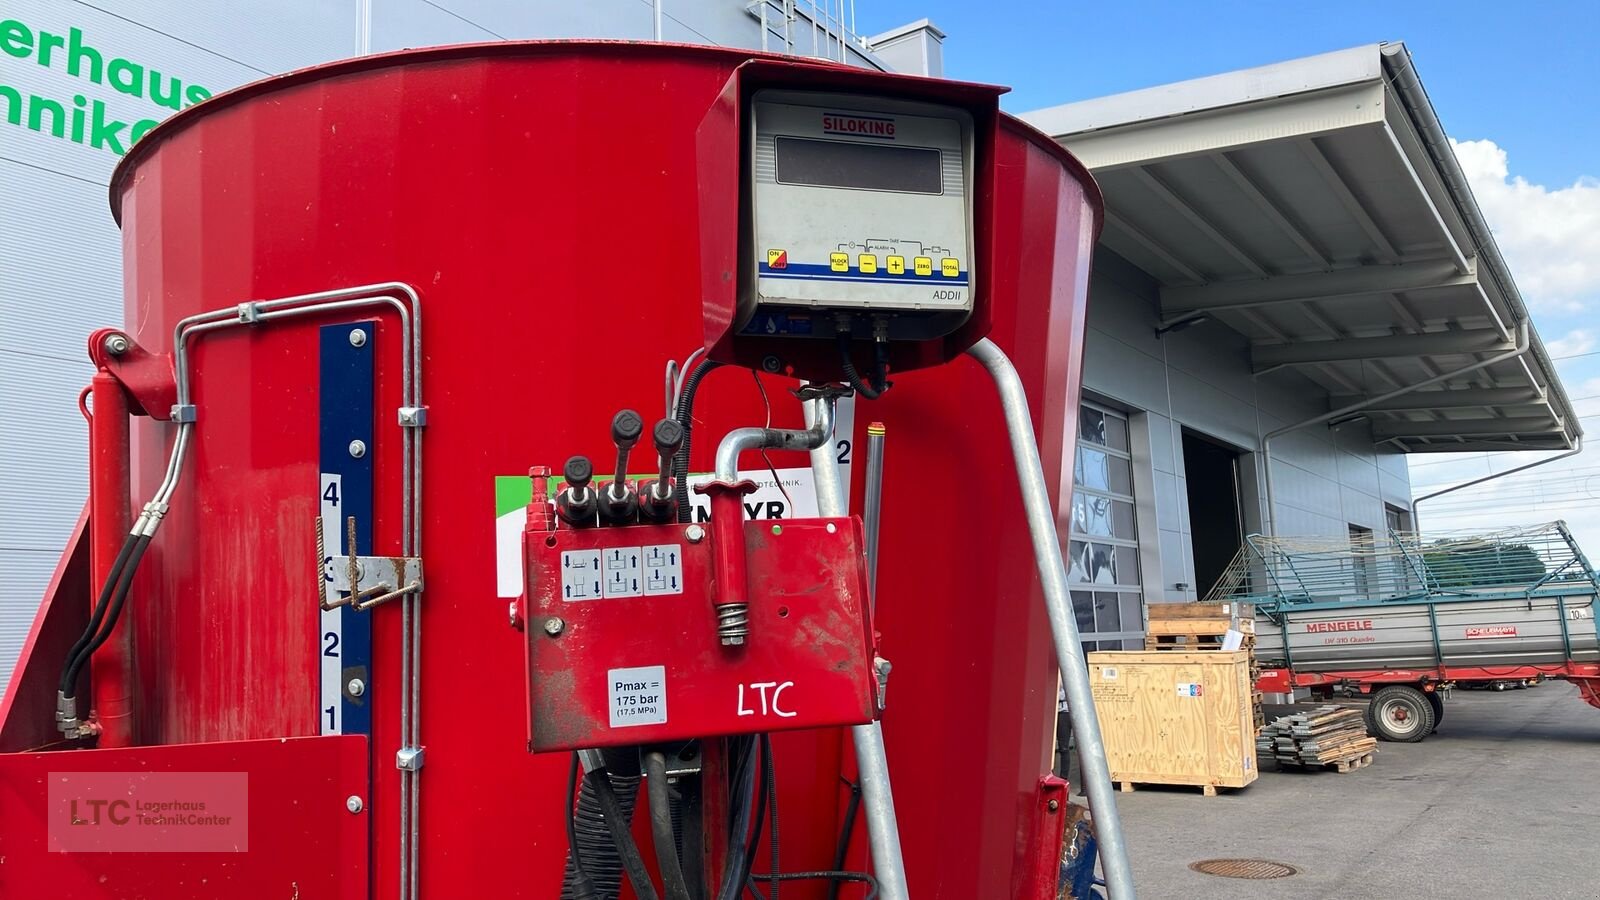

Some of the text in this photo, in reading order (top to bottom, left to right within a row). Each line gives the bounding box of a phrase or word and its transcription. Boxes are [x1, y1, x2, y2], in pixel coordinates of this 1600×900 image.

[823, 117, 895, 135] SILOKING
[837, 440, 851, 464] 2
[323, 482, 339, 507] 4
[1307, 621, 1372, 632] MENGELE
[323, 632, 339, 657] 2
[615, 682, 647, 691] Pmax
[616, 695, 658, 706] 175 bar
[737, 681, 797, 717] LTC
[325, 706, 336, 730] 1
[616, 706, 656, 717] (17,5 MPa)
